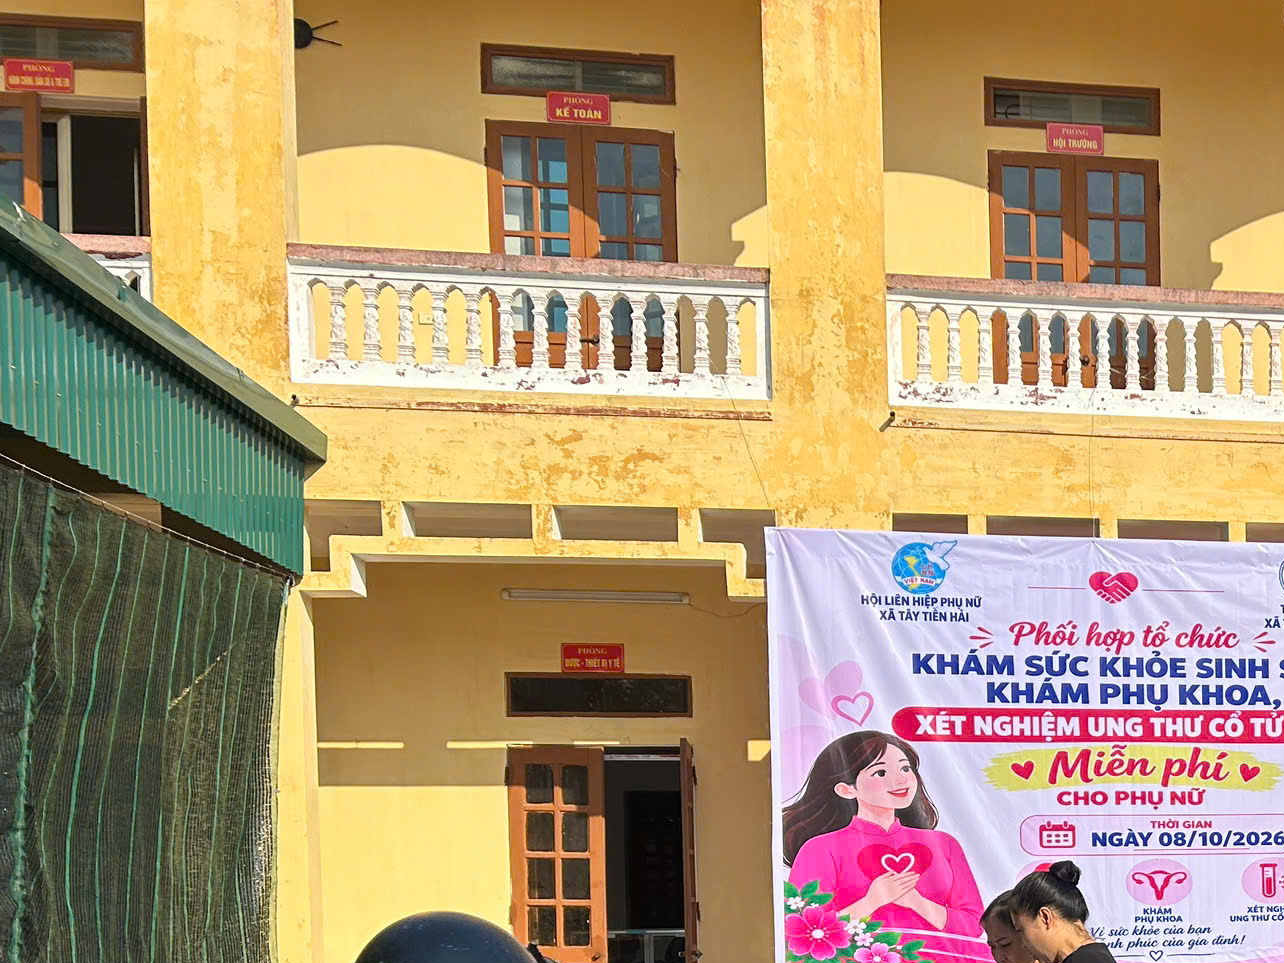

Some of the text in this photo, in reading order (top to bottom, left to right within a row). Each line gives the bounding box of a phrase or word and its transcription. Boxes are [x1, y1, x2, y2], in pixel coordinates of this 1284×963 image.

[563, 96, 593, 104] PHÒNG
[556, 106, 602, 119] KẾ TOÁN
[1062, 127, 1089, 136] PHÒNG
[1053, 137, 1098, 149] HỘI TRƯỜNG
[861, 593, 982, 610] HỘI LIÊN HIỆP PHỤ NỮ
[880, 606, 969, 622] XÃ TÂY TIỀN HẢI
[1264, 616, 1281, 628] XÃ
[1008, 620, 1241, 655] Phối hợp tổ chức
[577, 646, 608, 655] PHÒNG
[912, 649, 1015, 676] KHÁM
[1024, 650, 1089, 677] SỨC
[1099, 650, 1187, 678] KHỎE
[1196, 658, 1270, 679] SINH
[986, 677, 1282, 711] KHÁM PHỤ KHOA,
[915, 711, 967, 736] XÉT
[974, 711, 1081, 742] NGHIỆM
[1087, 716, 1144, 737] UNG
[1150, 714, 1203, 737] THƯ
[1208, 710, 1245, 738] CỔ
[1250, 711, 1284, 737] TỬ
[1048, 744, 1231, 788] Miễn phí
[1056, 787, 1206, 810] CHO PHỤ NỮ
[1149, 818, 1212, 829] THỜI GIAN
[1091, 828, 1154, 847] NGÀY
[1143, 906, 1173, 915] KHÁM
[1247, 904, 1265, 913] XÉT
[1134, 915, 1183, 924] PHỤ KHOA
[1251, 913, 1270, 922] THƯ
[1108, 926, 1129, 937] sức
[1131, 924, 1160, 936] khỏe
[1163, 925, 1185, 935] của
[1187, 924, 1213, 936] bạn
[1126, 938, 1159, 951] phúc
[1162, 937, 1185, 948] của
[1187, 938, 1208, 950] gia
[1211, 934, 1246, 946] đình!
